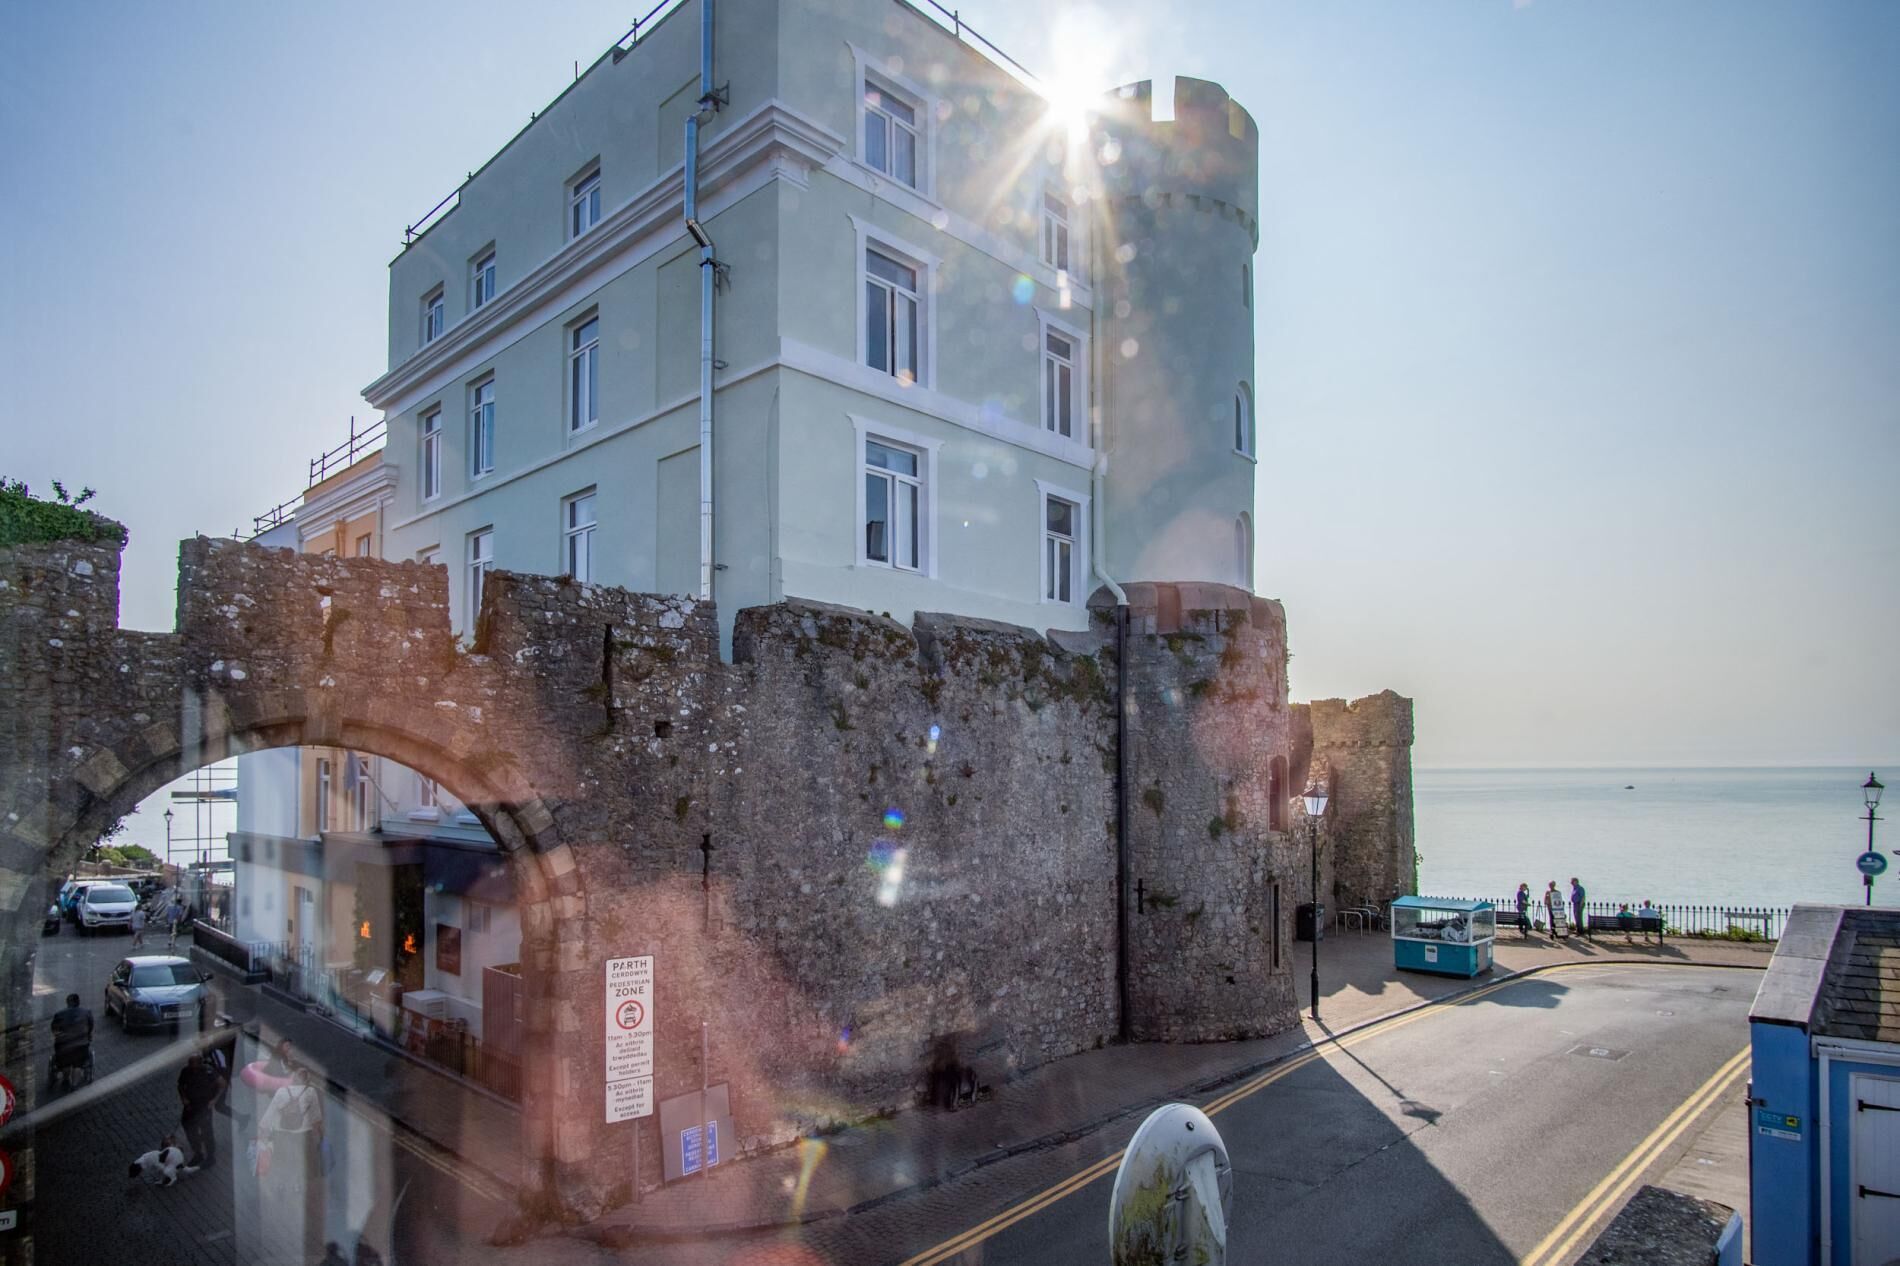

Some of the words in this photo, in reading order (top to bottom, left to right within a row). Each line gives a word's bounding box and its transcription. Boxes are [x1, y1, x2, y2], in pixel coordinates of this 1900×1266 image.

[613, 960, 647, 971] PARTH
[611, 970, 648, 979] CERDDWYR
[609, 979, 650, 988] PEDESTRIAN
[616, 986, 645, 997] ZONE
[609, 1063, 629, 1071] Except
[631, 1060, 650, 1068] permit
[619, 1068, 640, 1076] holders
[614, 1104, 635, 1112] Except
[620, 1110, 640, 1118] access
